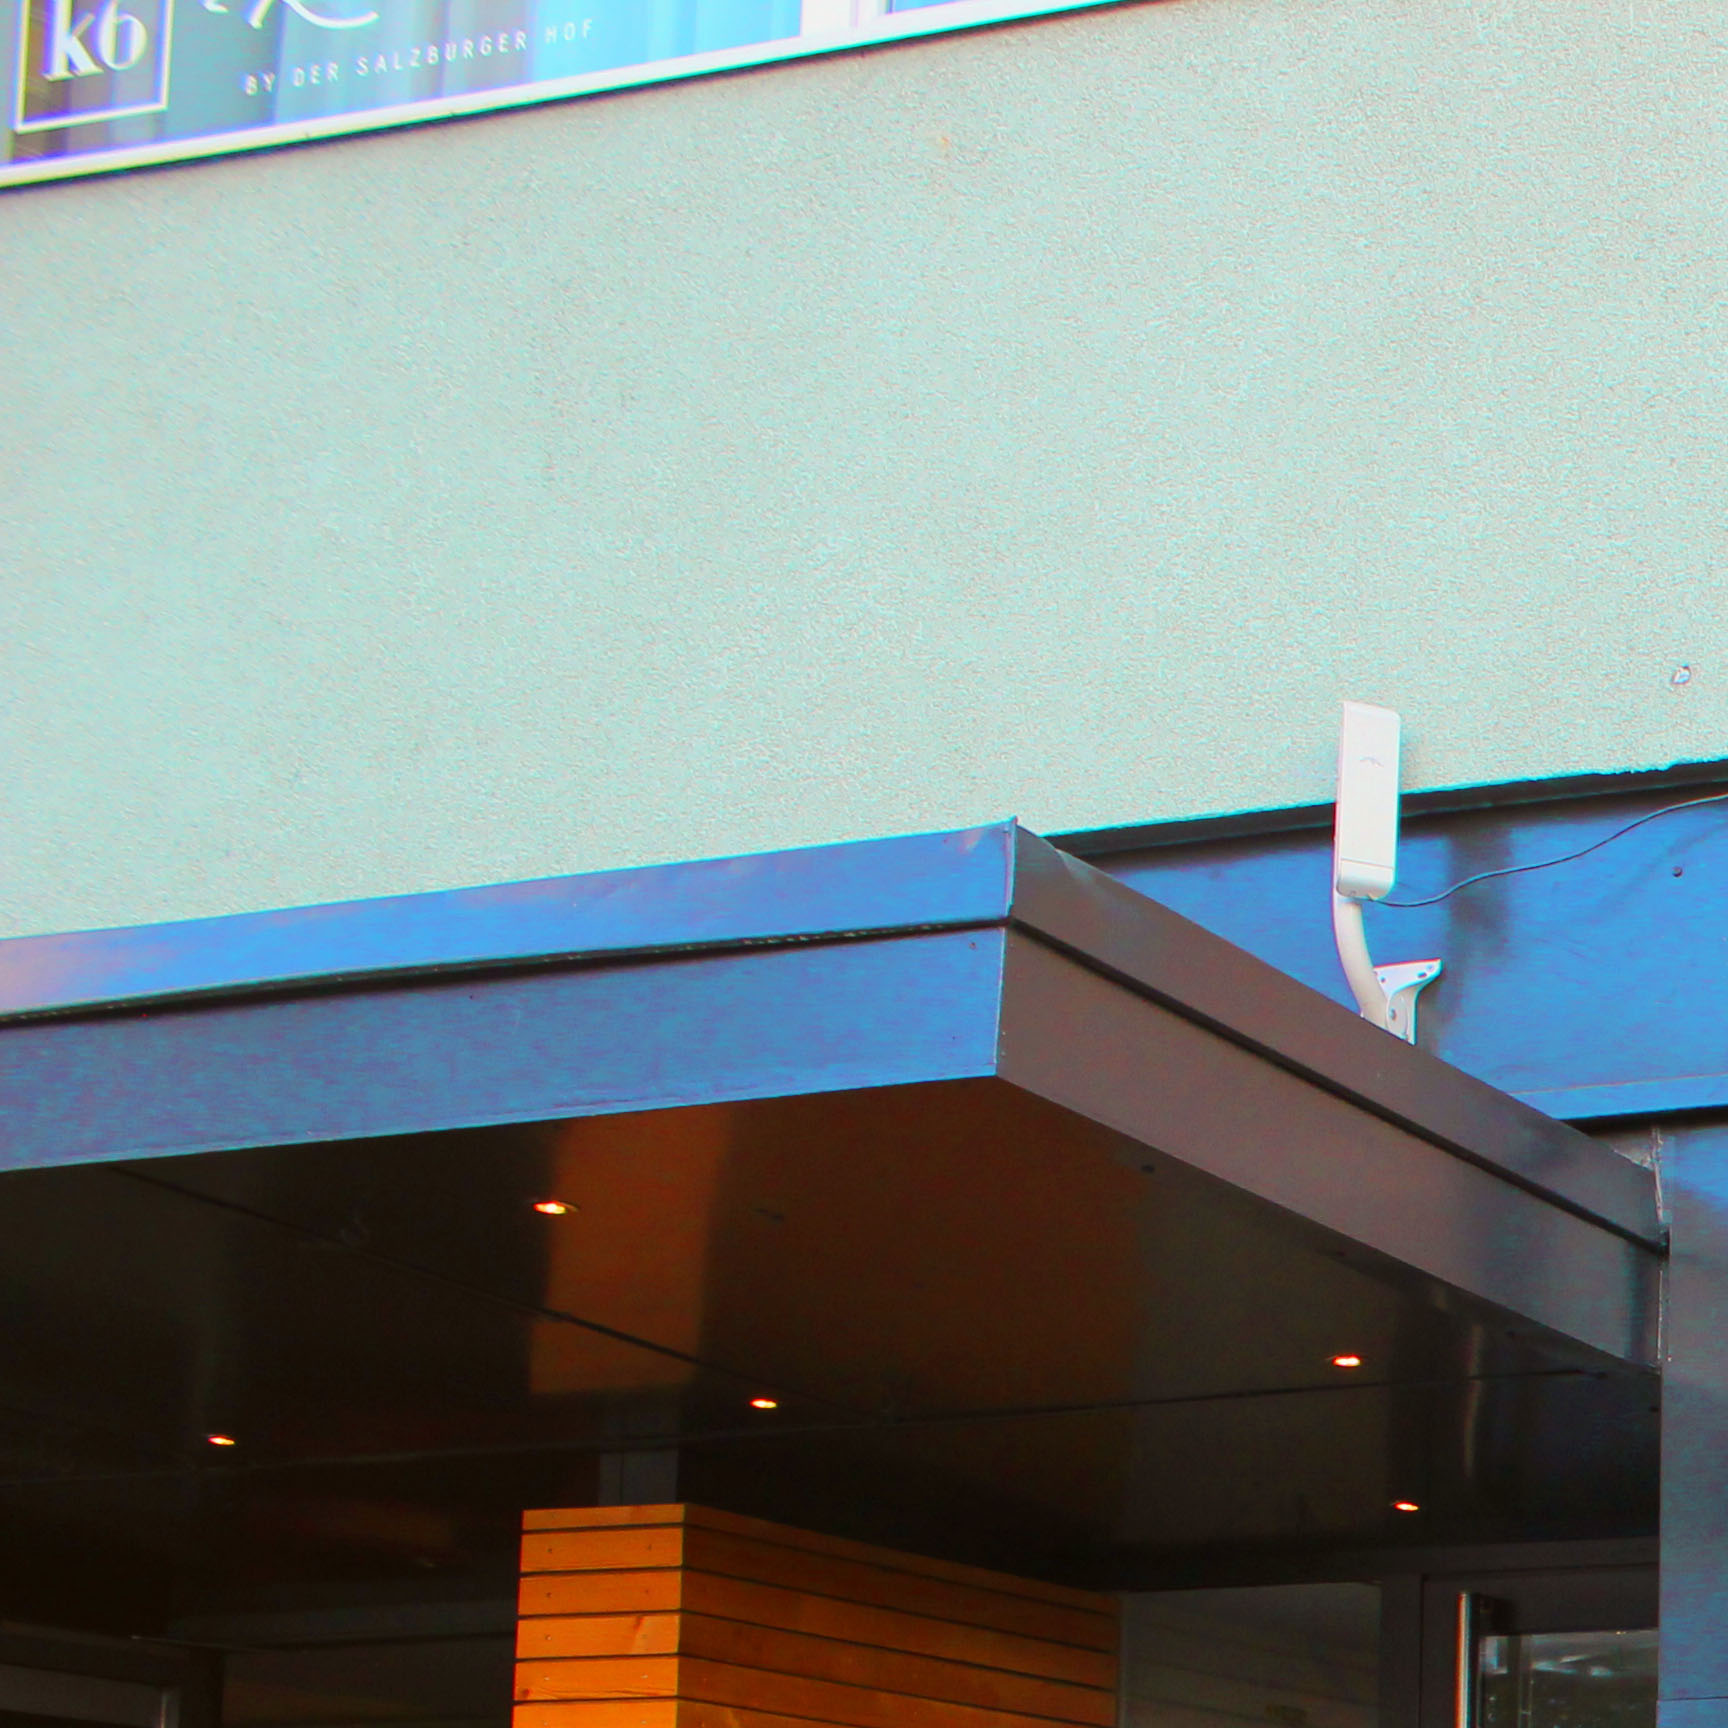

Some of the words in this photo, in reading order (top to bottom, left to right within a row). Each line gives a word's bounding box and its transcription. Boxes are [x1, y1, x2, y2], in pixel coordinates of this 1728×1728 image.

[244, 71, 276, 95] BY
[292, 62, 340, 88] DER
[356, 31, 528, 77] SALZBURGER
[545, 18, 594, 44] HOF
